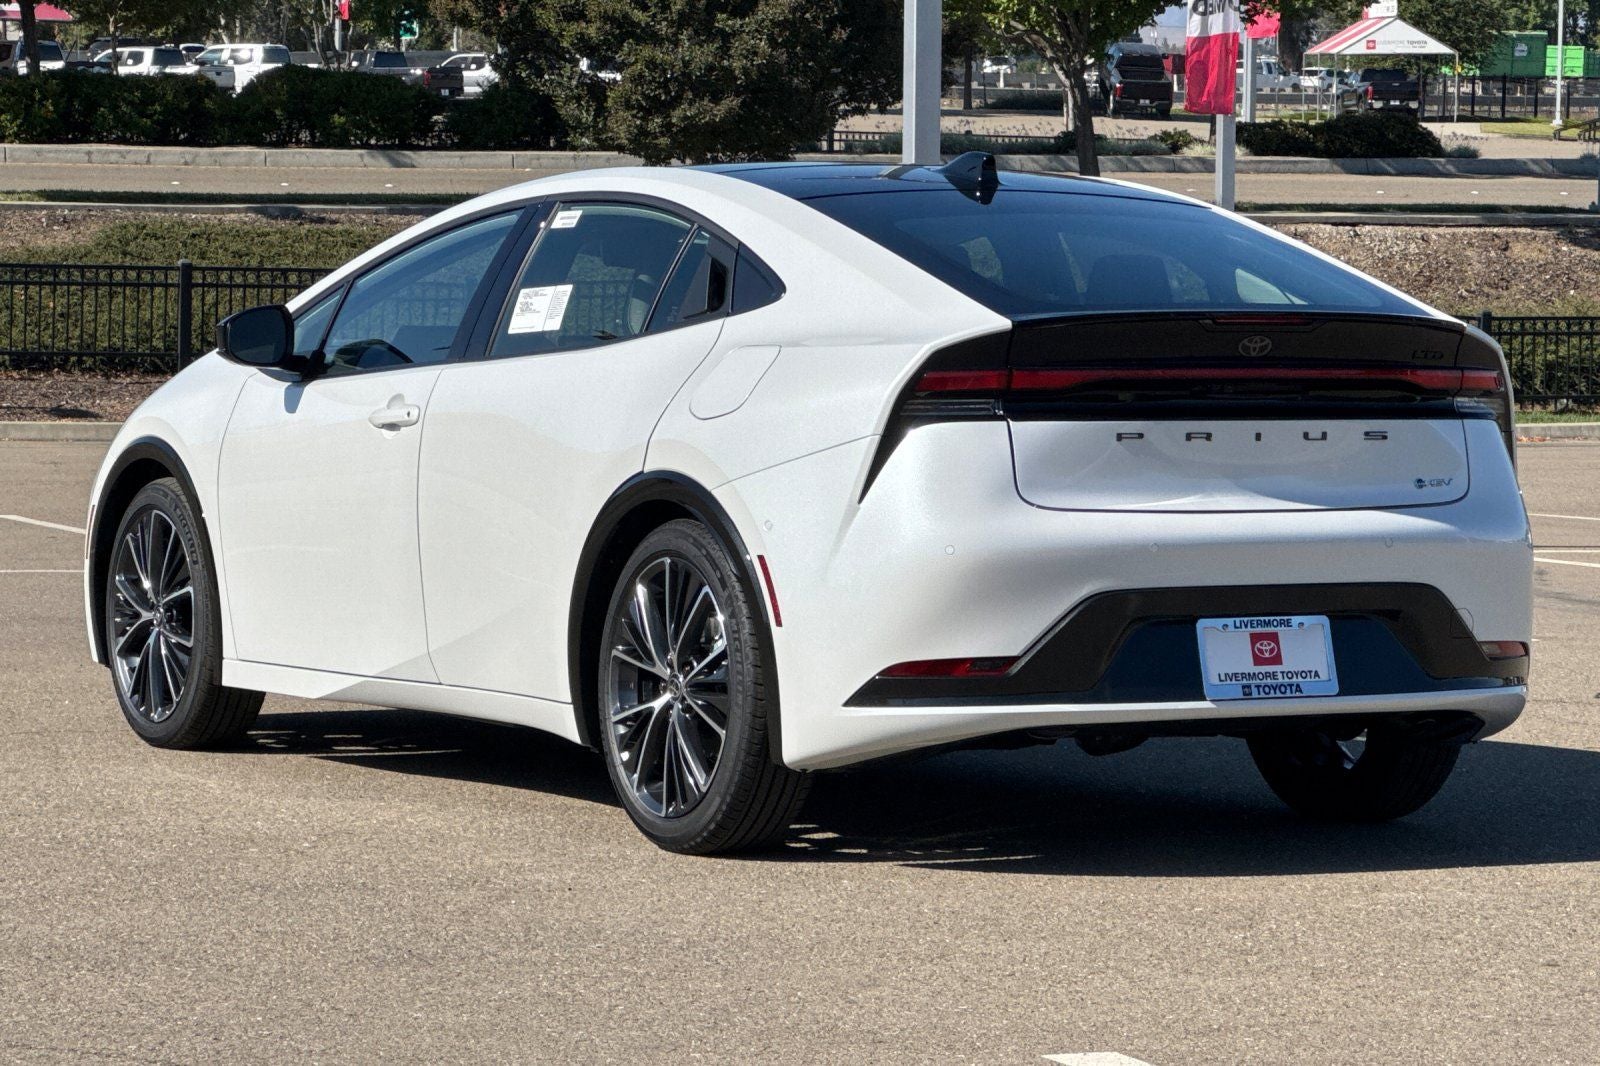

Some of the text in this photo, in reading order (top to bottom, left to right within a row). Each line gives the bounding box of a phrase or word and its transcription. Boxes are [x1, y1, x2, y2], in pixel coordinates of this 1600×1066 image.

[1116, 430, 1389, 442] PRIUS
[1233, 618, 1293, 630] LIVERMORE
[1218, 670, 1320, 683] LIVERMORE TOYOTA
[1254, 683, 1304, 696] TOYOTA
